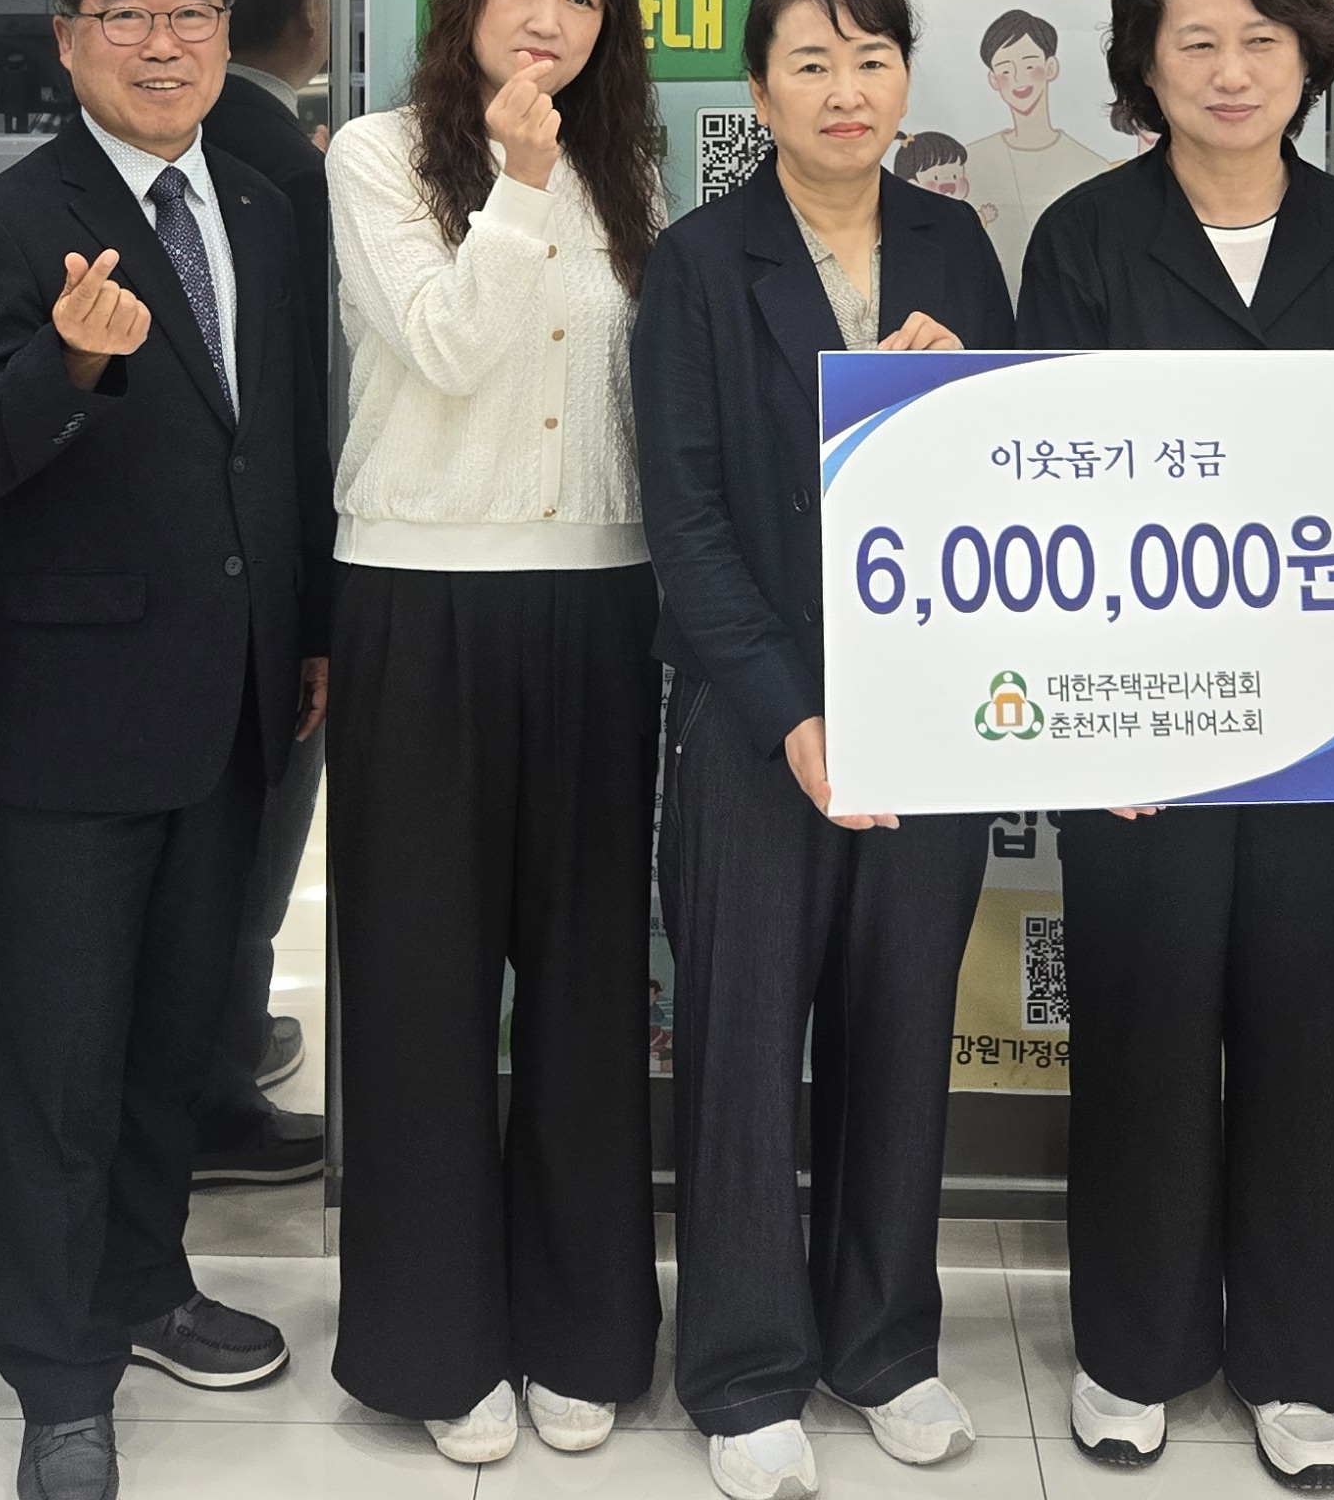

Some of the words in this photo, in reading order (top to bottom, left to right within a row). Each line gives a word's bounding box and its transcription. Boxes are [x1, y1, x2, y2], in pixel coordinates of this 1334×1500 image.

[989, 438, 1136, 480] 이웃돕기
[1153, 438, 1228, 479] 성금
[1047, 669, 1263, 702] 대한주택관리사협회
[1048, 709, 1142, 739] 춘천지부
[1149, 708, 1264, 737] 봄내여소회
